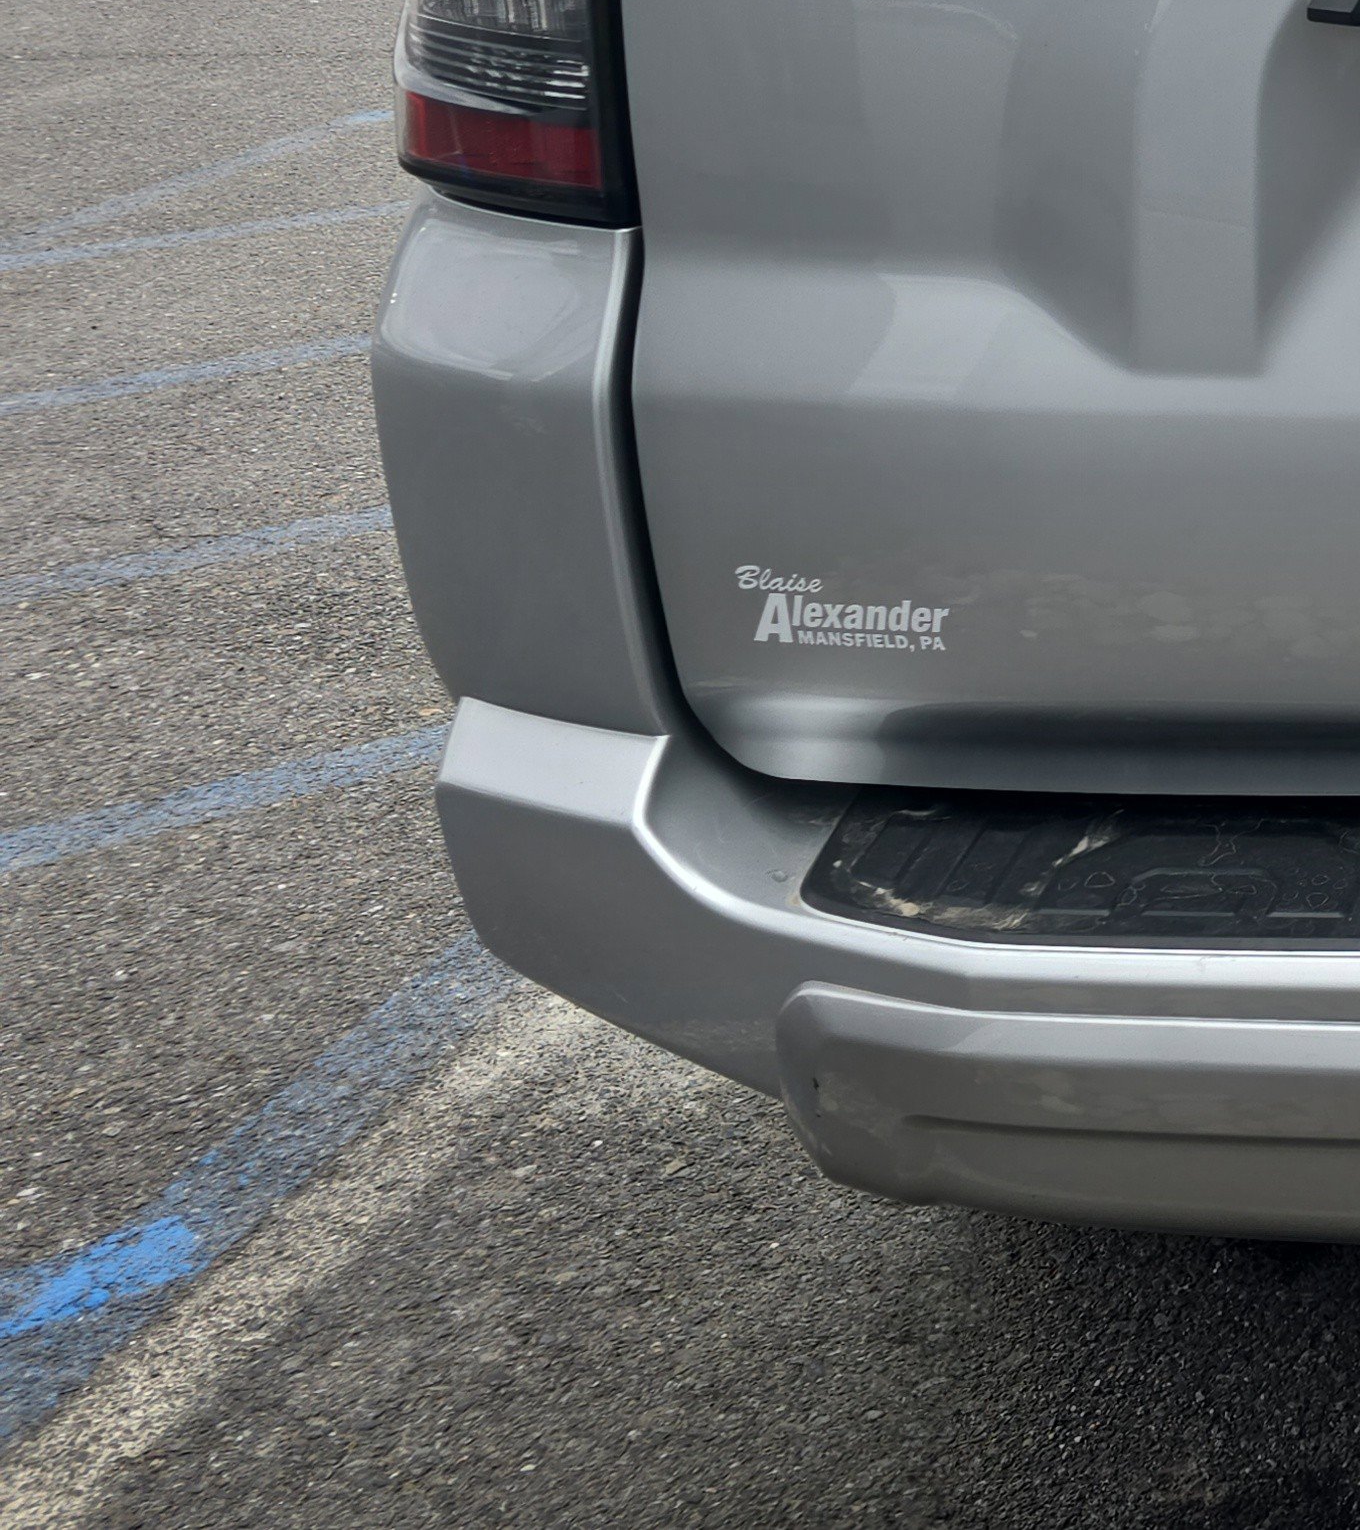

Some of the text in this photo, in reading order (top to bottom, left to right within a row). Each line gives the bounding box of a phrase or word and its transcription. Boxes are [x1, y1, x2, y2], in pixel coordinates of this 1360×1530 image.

[734, 564, 824, 593] Blaise
[753, 592, 950, 644] Alexander
[798, 630, 946, 652] MANSFIELD, PA
